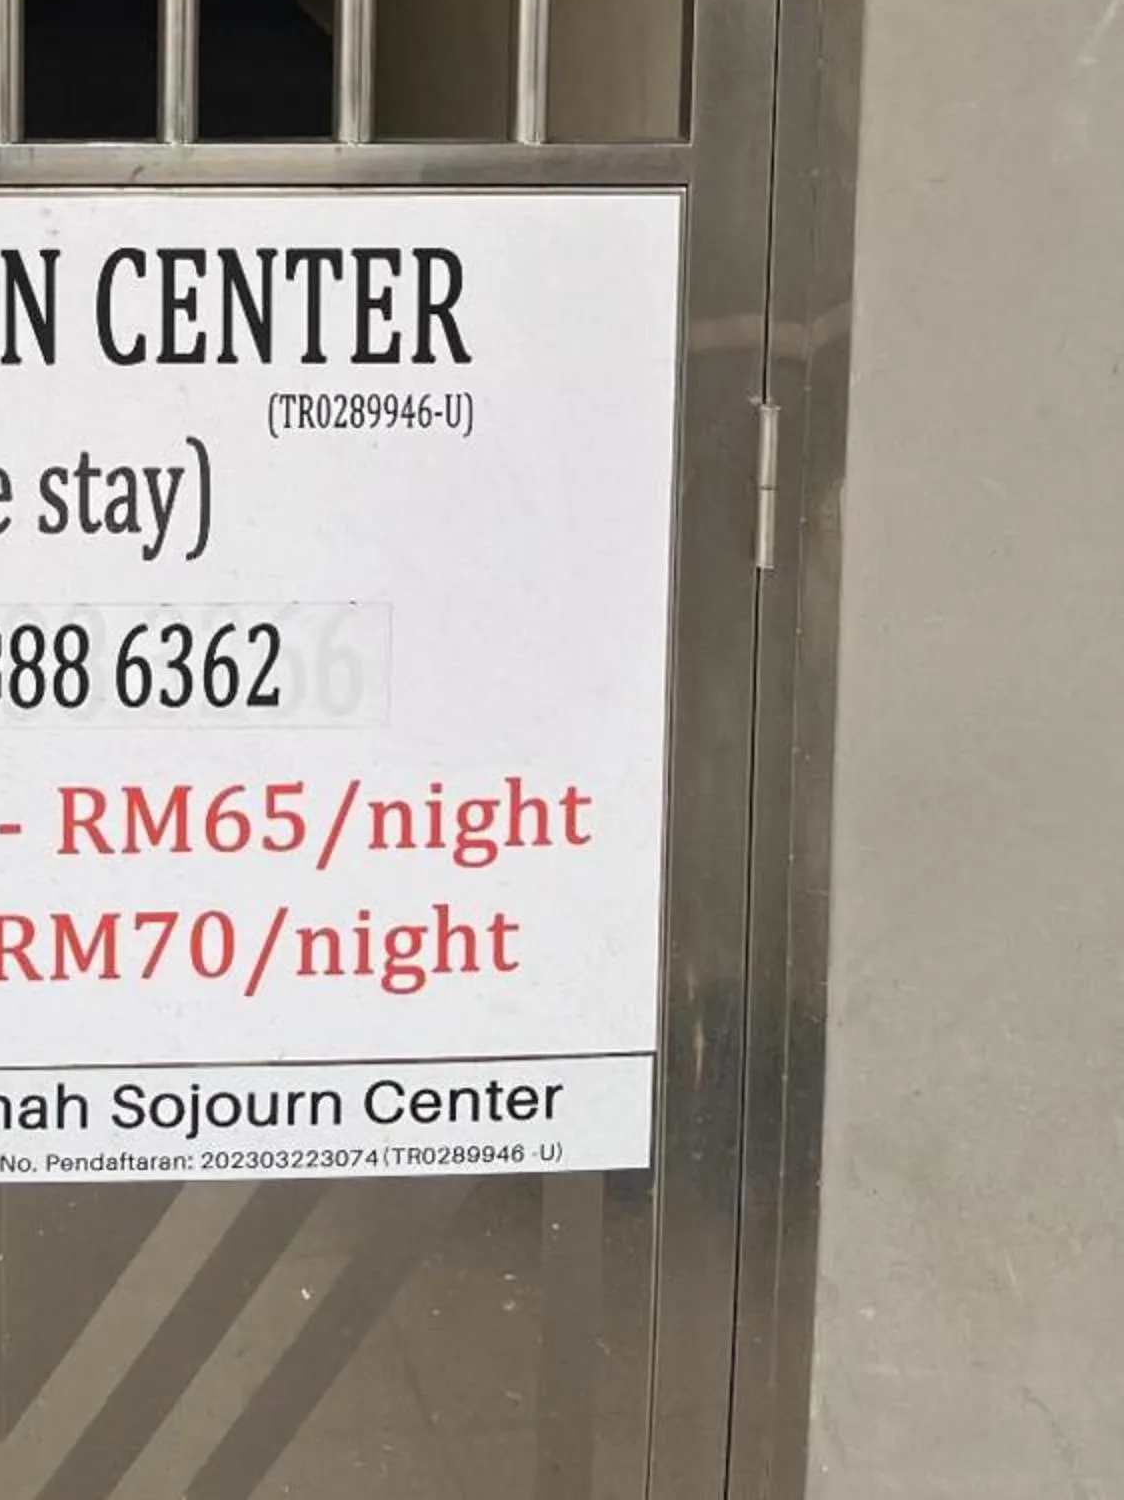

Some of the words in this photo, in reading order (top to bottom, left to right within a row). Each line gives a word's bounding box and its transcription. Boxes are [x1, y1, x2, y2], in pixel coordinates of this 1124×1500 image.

[95, 247, 473, 367] CENTER
[268, 392, 474, 439] (TR0289946-U)
[38, 436, 211, 561] stay)
[115, 622, 281, 709] 6362
[59, 776, 592, 870] RM65/night
[111, 1081, 342, 1140] Sojourn
[363, 1078, 564, 1125] Center
[0, 1154, 37, 1173] No.
[46, 1152, 193, 1173] Pendaftaran:
